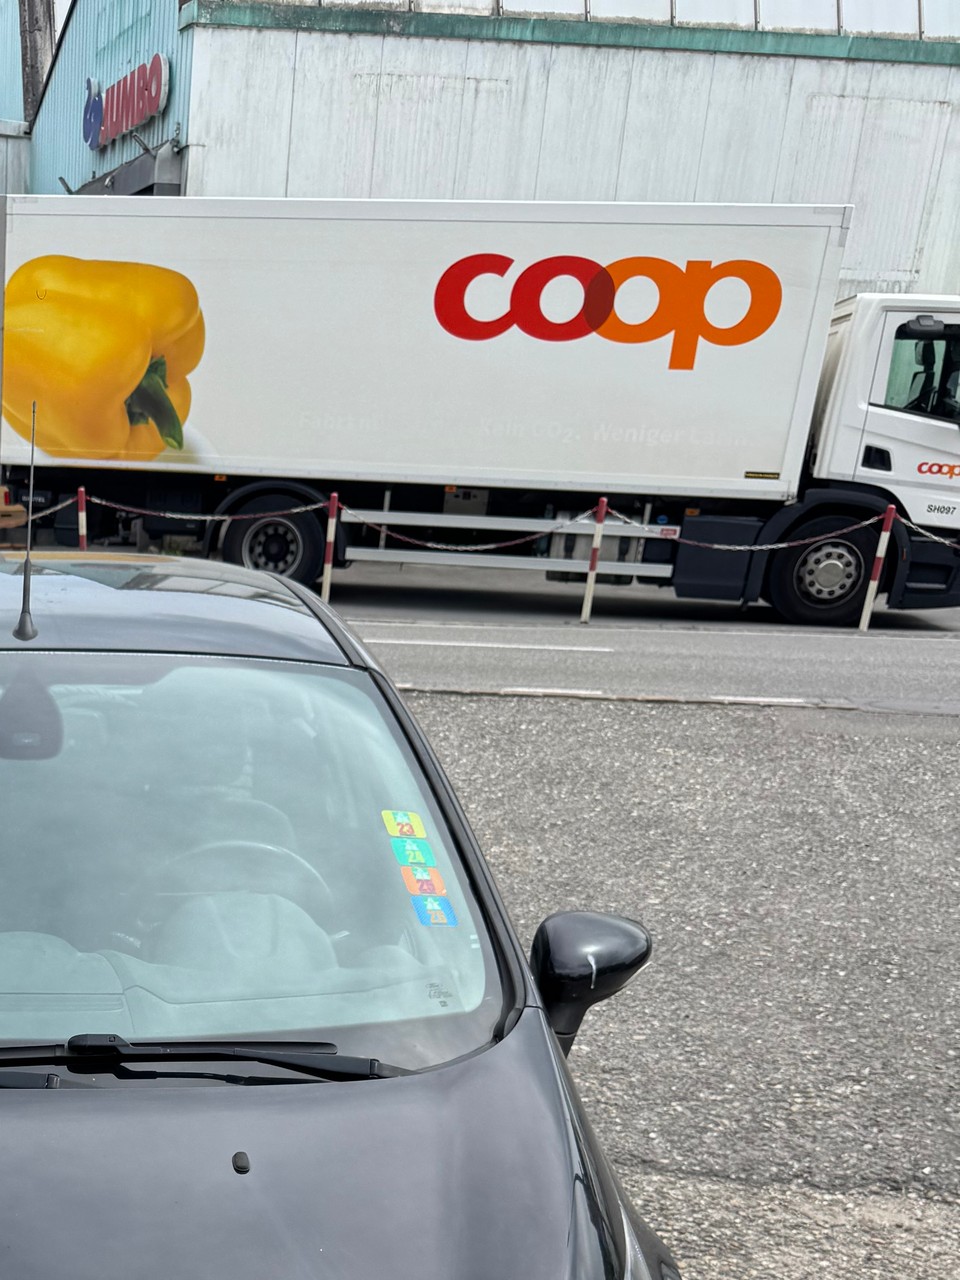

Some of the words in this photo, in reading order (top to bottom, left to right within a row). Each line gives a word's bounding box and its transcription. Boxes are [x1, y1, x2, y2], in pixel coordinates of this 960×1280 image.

[99, 53, 162, 145] JUMBO
[434, 252, 783, 371] coop
[593, 422, 685, 447] Weniger
[917, 461, 960, 479] coop
[926, 504, 957, 515] SH097
[396, 822, 416, 835] 23
[405, 850, 426, 863] 24
